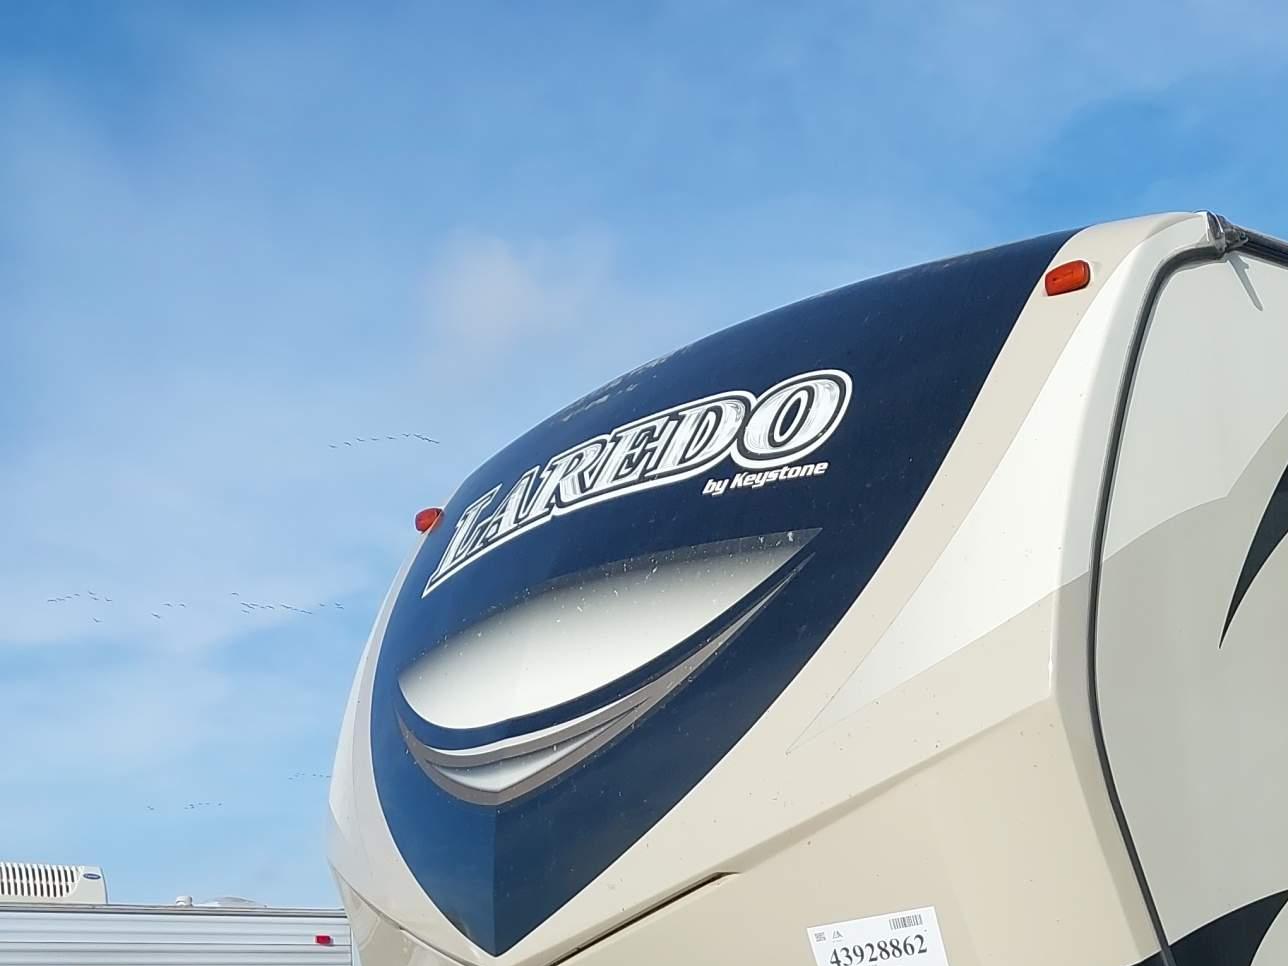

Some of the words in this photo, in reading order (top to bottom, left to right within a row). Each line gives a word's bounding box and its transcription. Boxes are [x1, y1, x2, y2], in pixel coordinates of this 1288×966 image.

[422, 369, 853, 598] LAREDO
[702, 479, 729, 496] by
[730, 462, 828, 488] Keystone
[829, 934, 927, 966] 43928862
